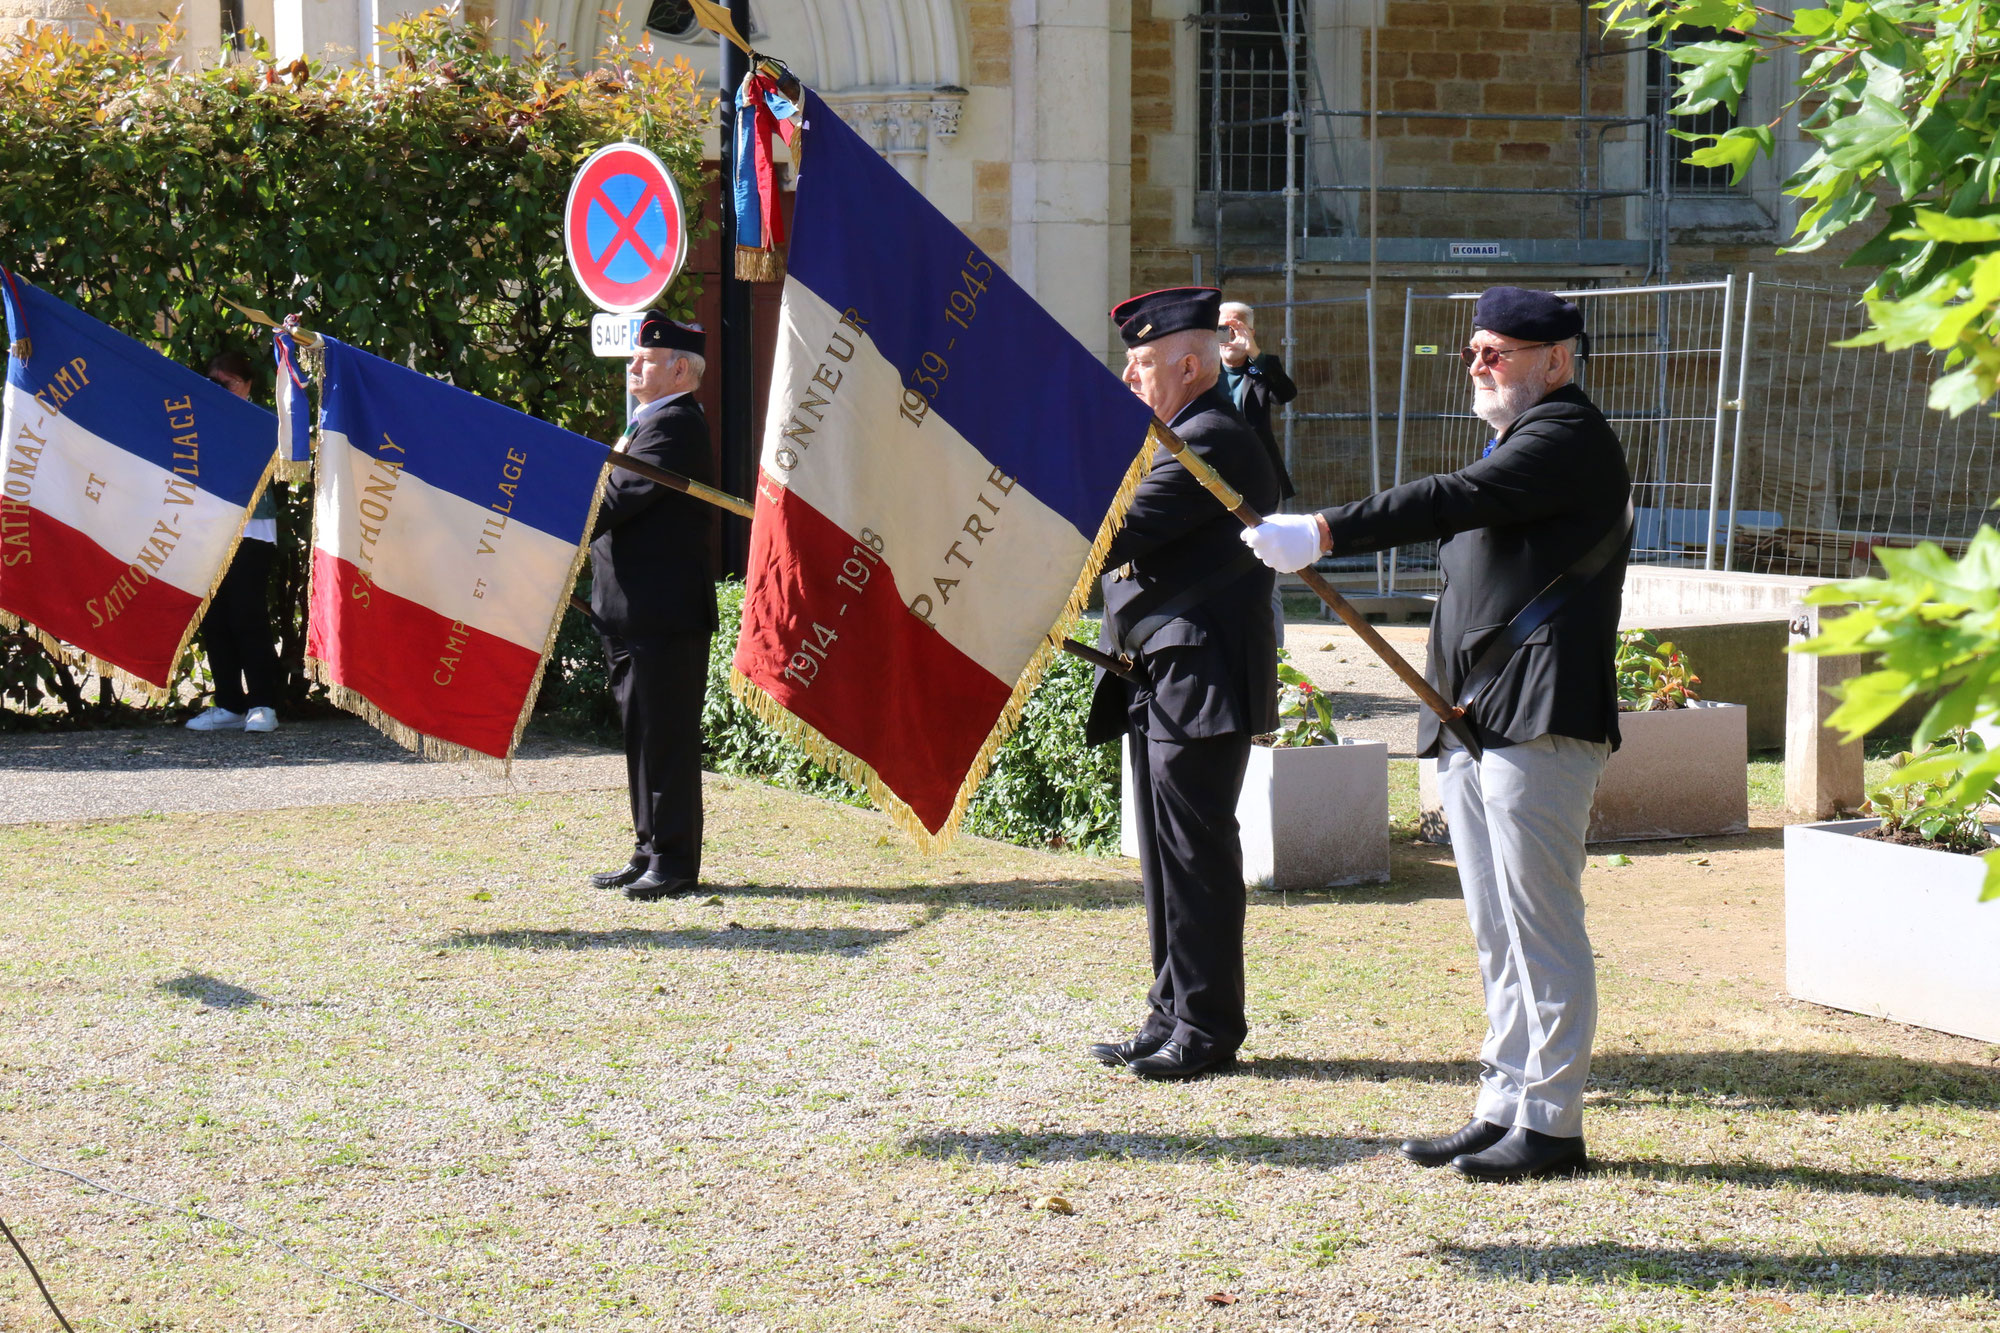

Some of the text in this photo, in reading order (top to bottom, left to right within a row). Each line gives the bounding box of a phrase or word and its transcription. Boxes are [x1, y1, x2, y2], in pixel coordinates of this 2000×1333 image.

[596, 324, 628, 346] SAUF
[1461, 246, 1498, 254] COMABI
[758, 306, 871, 506] HONNEUR
[899, 351, 949, 428] 1939
[944, 250, 993, 330] 1945
[3, 356, 91, 567] SATHONAY-CAMP
[85, 472, 107, 504] ET
[351, 432, 406, 609] SATHONAY
[433, 447, 527, 686] CAMP ET VILLAGE
[784, 621, 839, 689] 1914
[836, 527, 885, 595] 1918
[908, 465, 1018, 632] PATRIE
